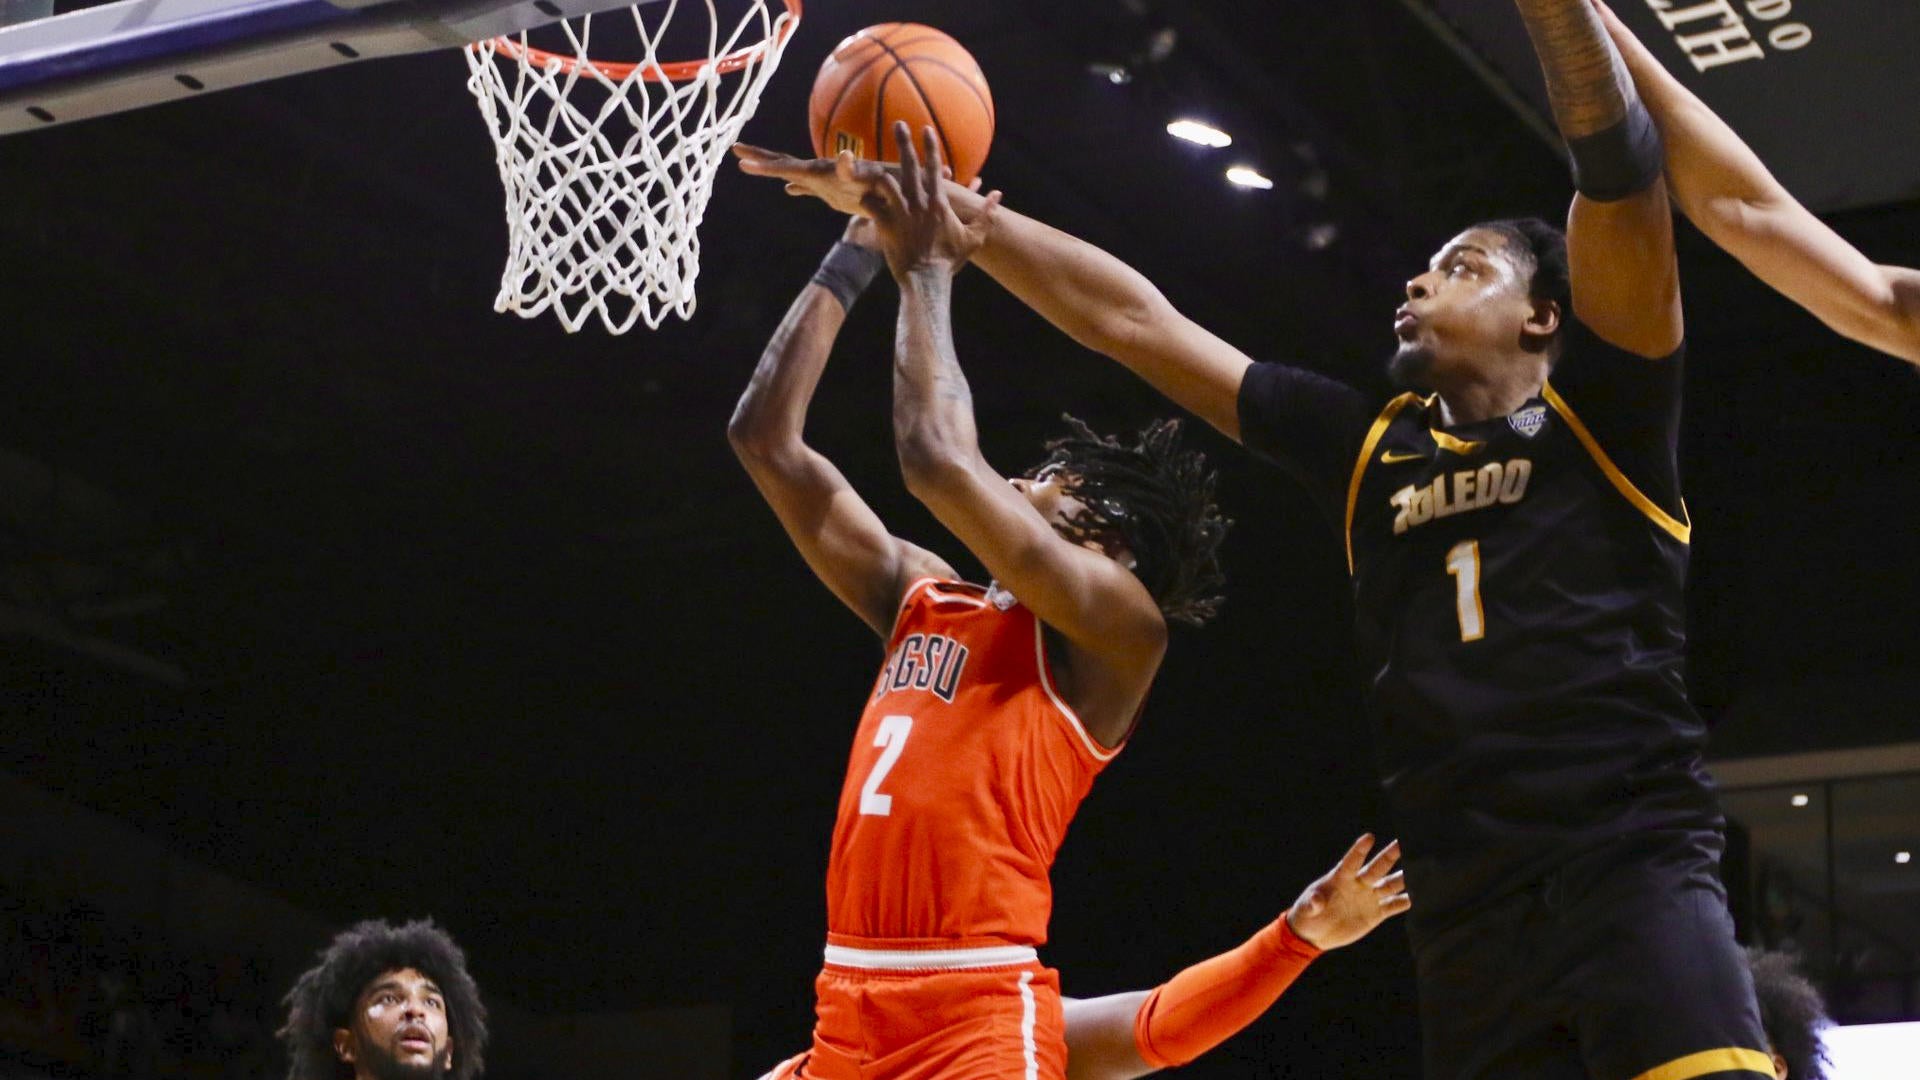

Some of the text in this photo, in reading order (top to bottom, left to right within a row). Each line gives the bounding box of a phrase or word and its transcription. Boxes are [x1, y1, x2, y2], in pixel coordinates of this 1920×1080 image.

[1646, 0, 1764, 73] TH
[1389, 458, 1532, 535] TOLEDO
[1446, 539, 1485, 642] 1
[859, 714, 913, 816] 2
